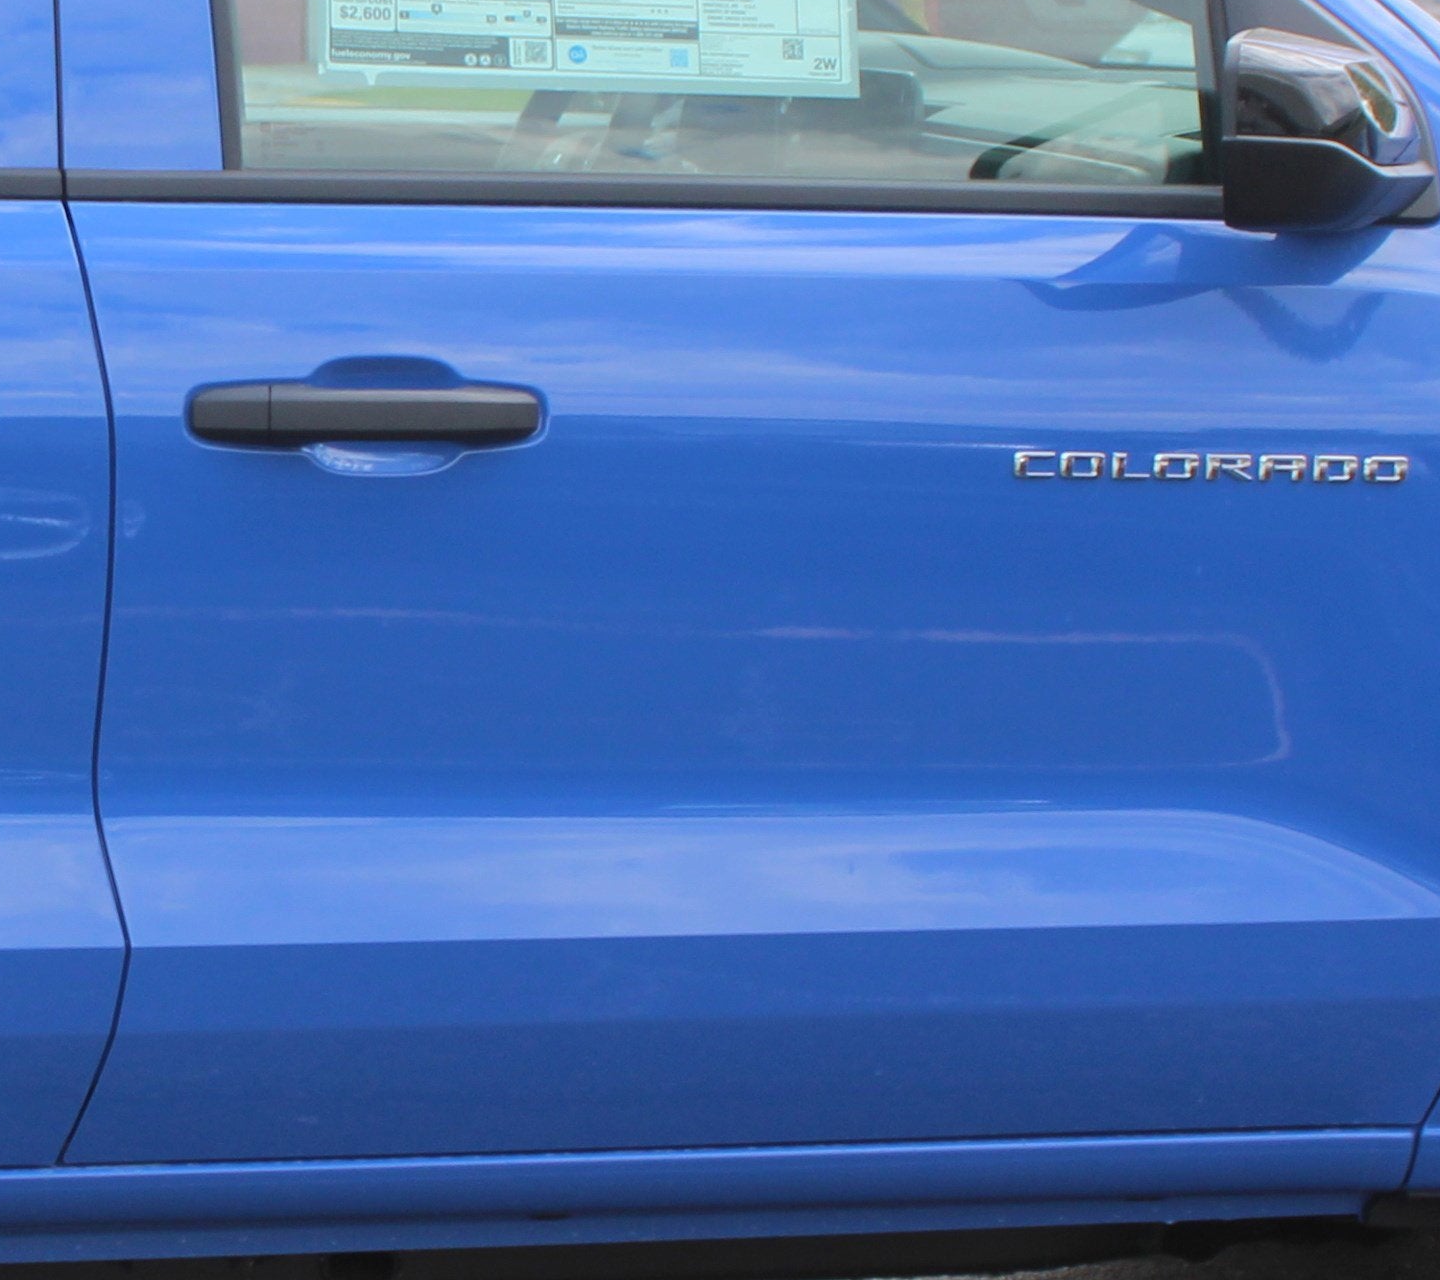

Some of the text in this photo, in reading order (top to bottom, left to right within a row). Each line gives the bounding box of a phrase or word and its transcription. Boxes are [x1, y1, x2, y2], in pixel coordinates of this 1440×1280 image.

[339, 5, 392, 21] $2,600
[331, 47, 412, 62] fueleconomy.gov
[813, 57, 838, 71] 2W
[1012, 451, 1410, 484] COLORADO
